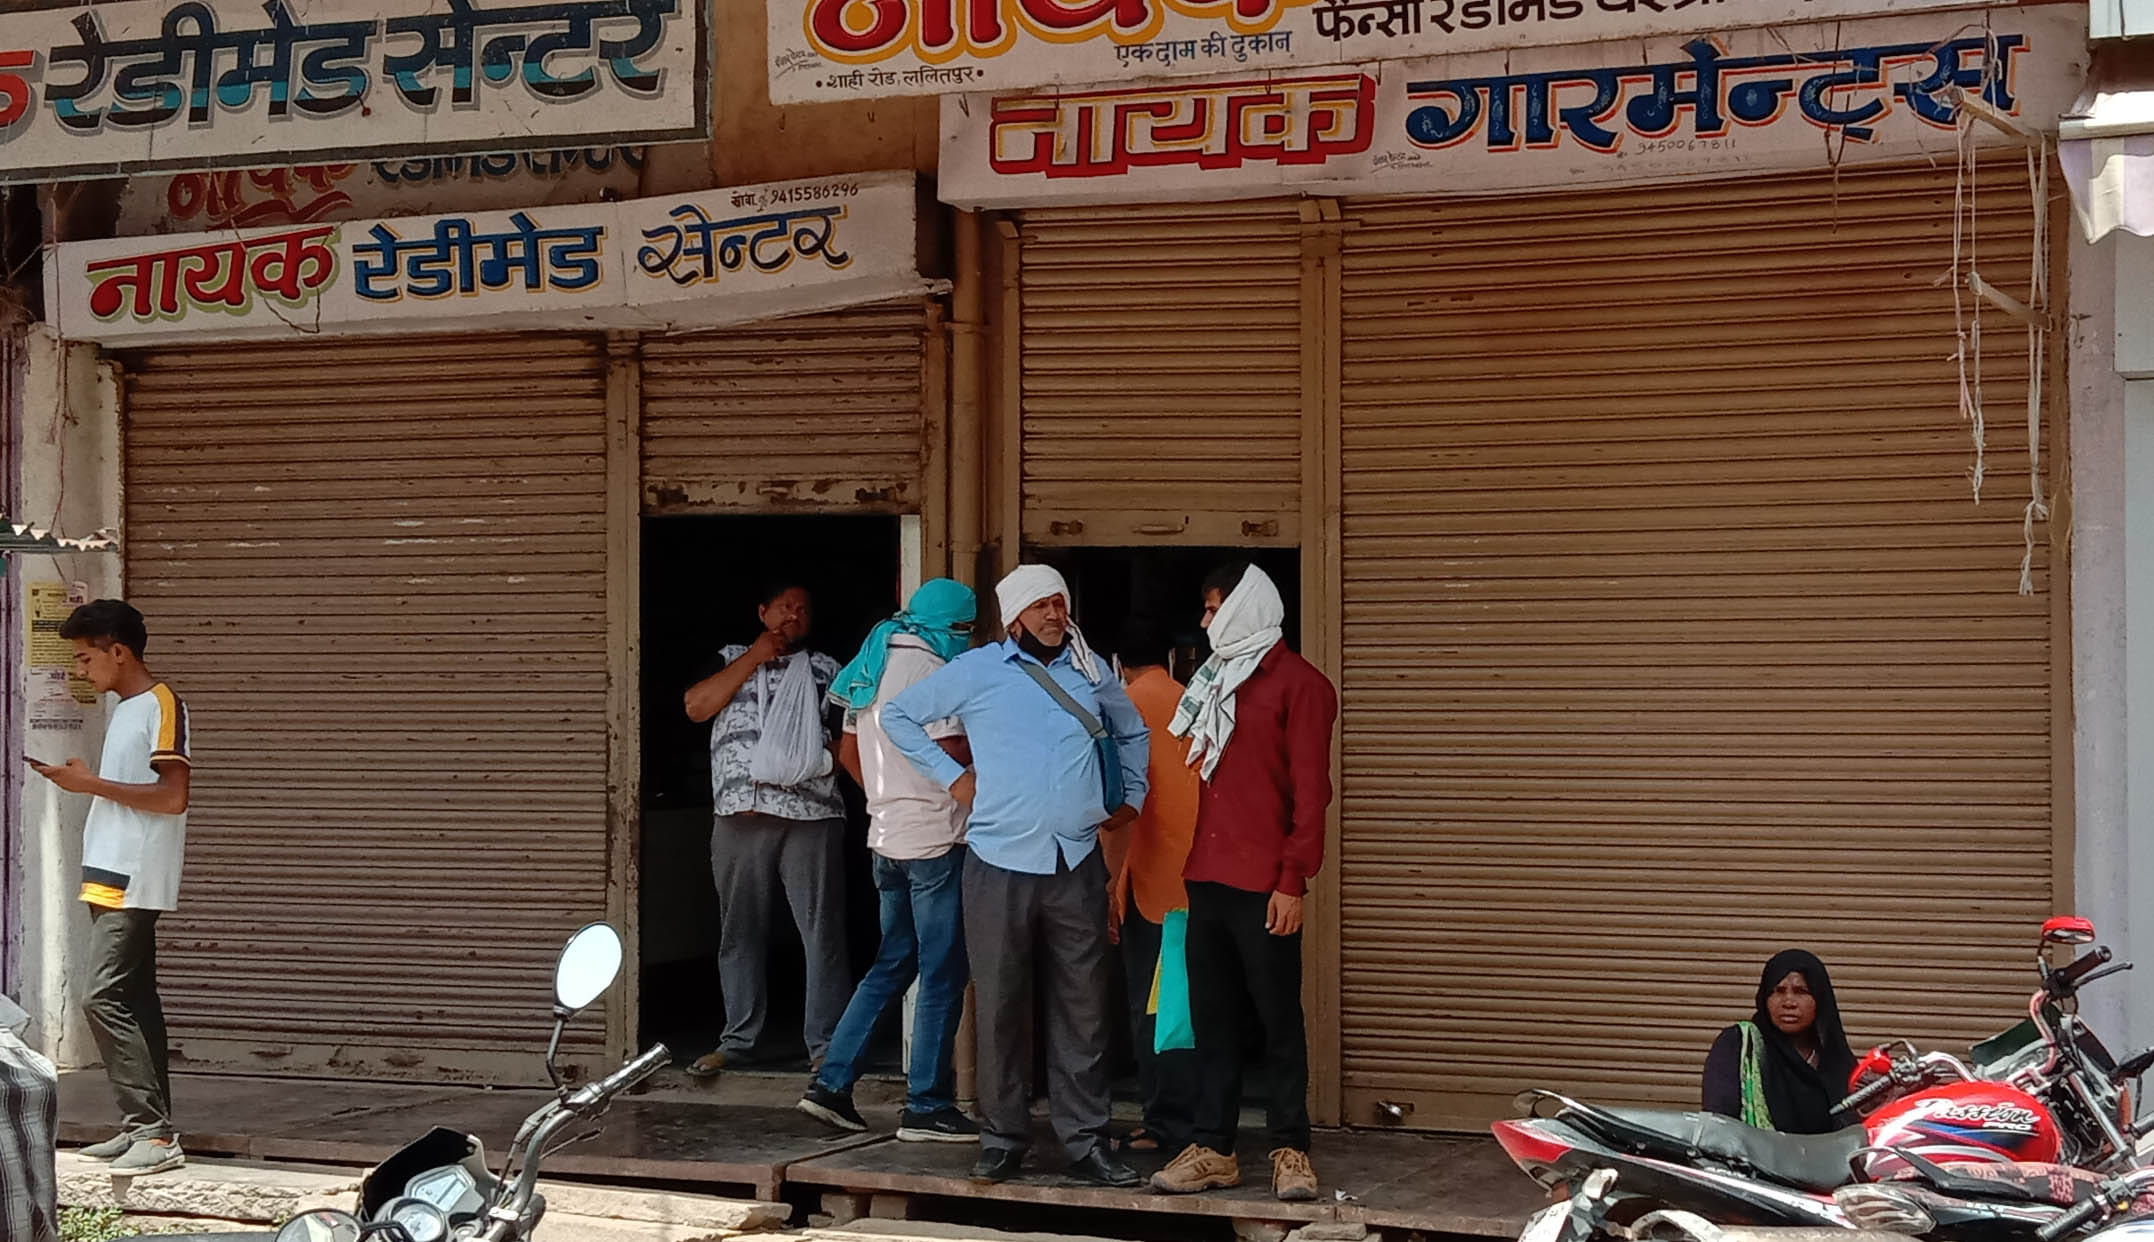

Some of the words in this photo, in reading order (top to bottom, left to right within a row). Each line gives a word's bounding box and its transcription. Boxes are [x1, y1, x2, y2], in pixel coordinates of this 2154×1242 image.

[45, 0, 377, 130] रेडीमेड
[383, 0, 677, 108] सेन्टर
[827, 70, 864, 90] शाही
[902, 65, 975, 88] ललितपुर
[1200, 31, 1228, 57] की
[1230, 30, 1292, 62] दुकान
[990, 76, 1375, 178] नायक
[769, 183, 859, 206] 9415586296
[87, 224, 340, 318] नायक
[353, 212, 605, 297] रेडीमेड
[637, 203, 850, 286] सेन्टर
